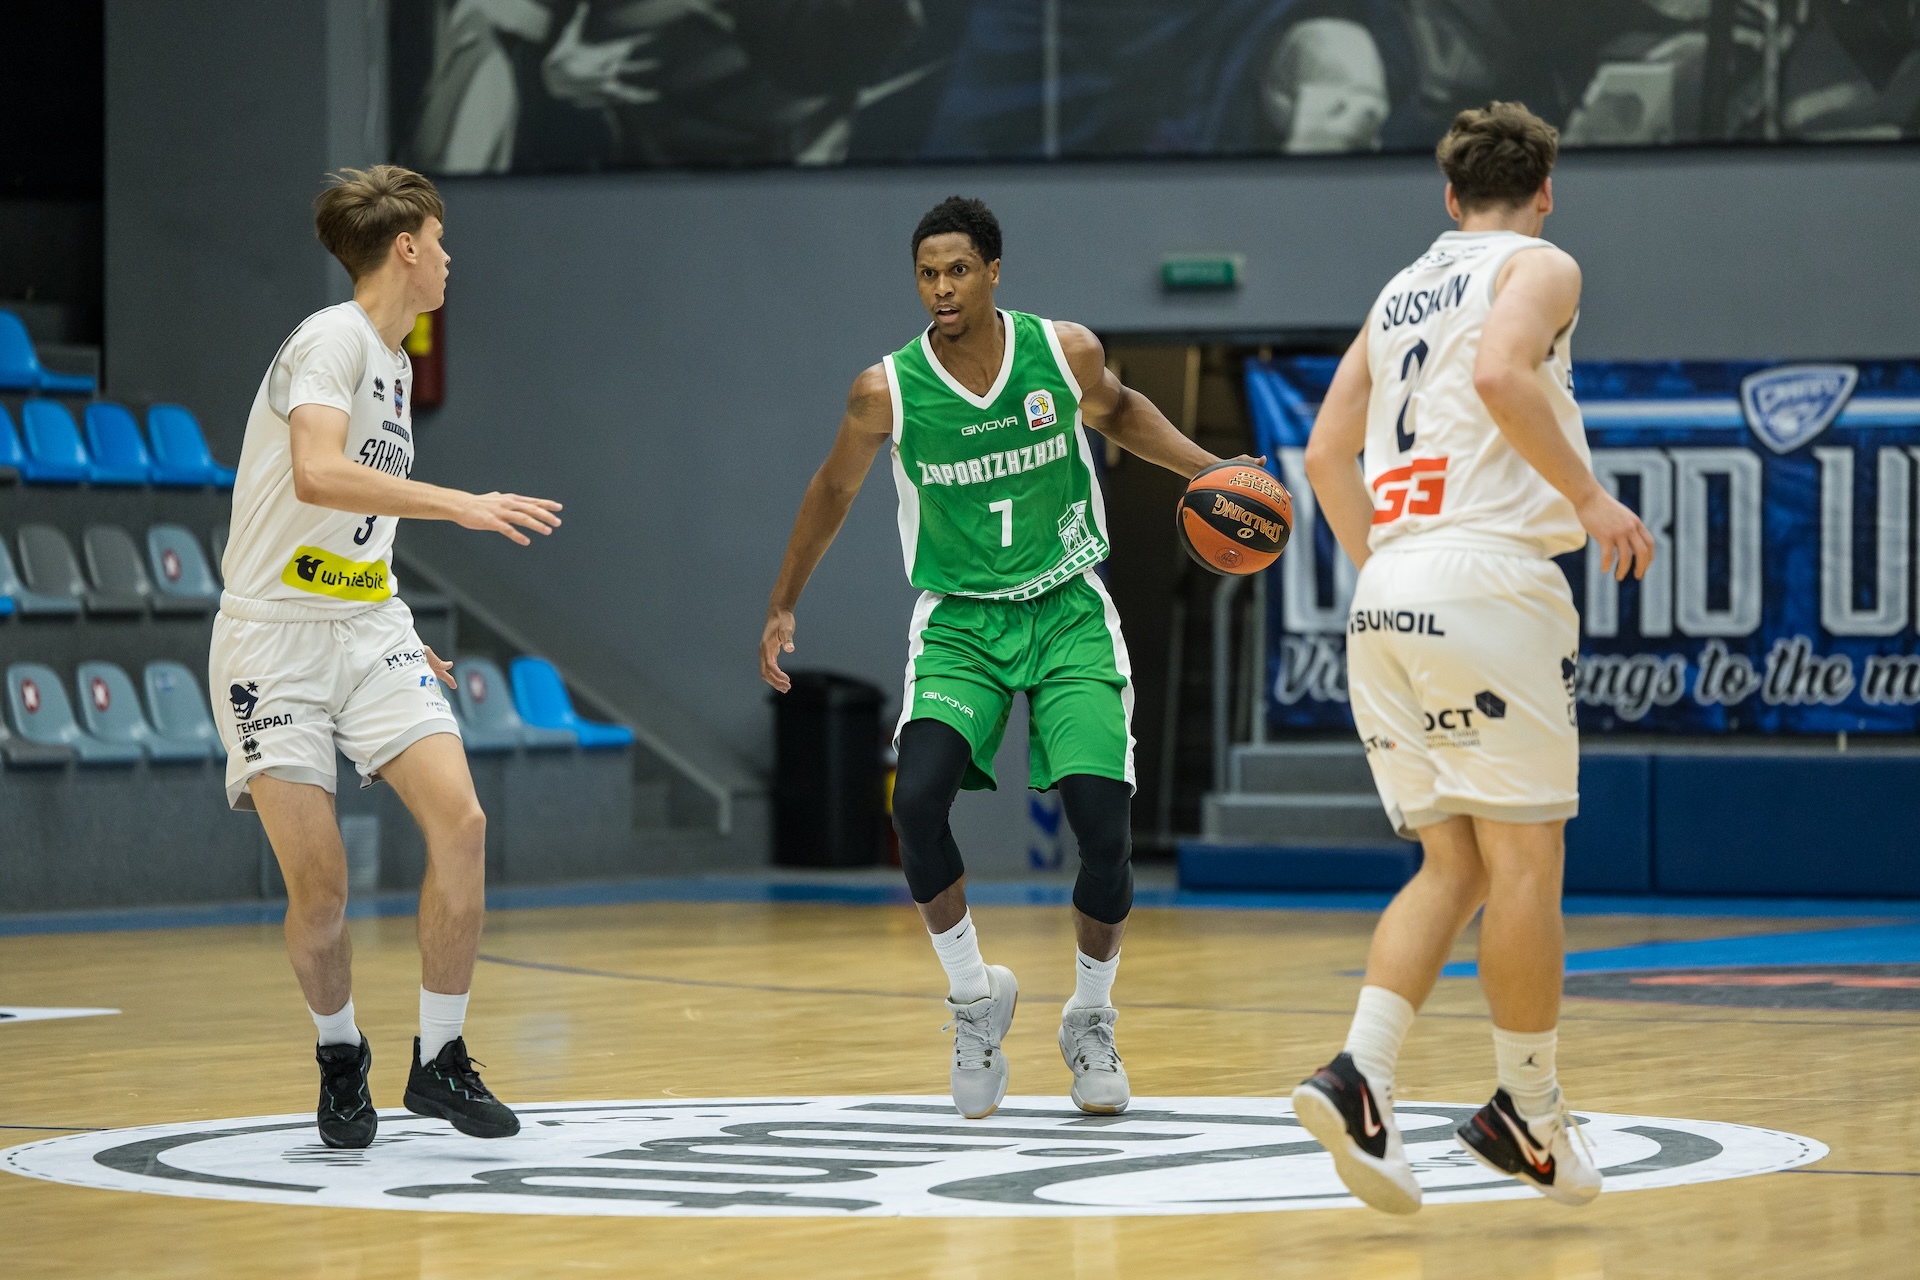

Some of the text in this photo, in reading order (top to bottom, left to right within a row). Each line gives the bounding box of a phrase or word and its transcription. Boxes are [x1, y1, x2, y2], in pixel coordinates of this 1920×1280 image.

[1396, 339, 1429, 454] 2
[961, 416, 1018, 436] GIVOVA
[916, 433, 1068, 486] ZAPORIZHZHIA
[989, 499, 1013, 547] 7
[1211, 495, 1284, 543] SPALDING
[1763, 637, 1855, 705] the
[236, 713, 293, 735] ГЕНЕРАЛ
[922, 691, 974, 718] GIVOVA
